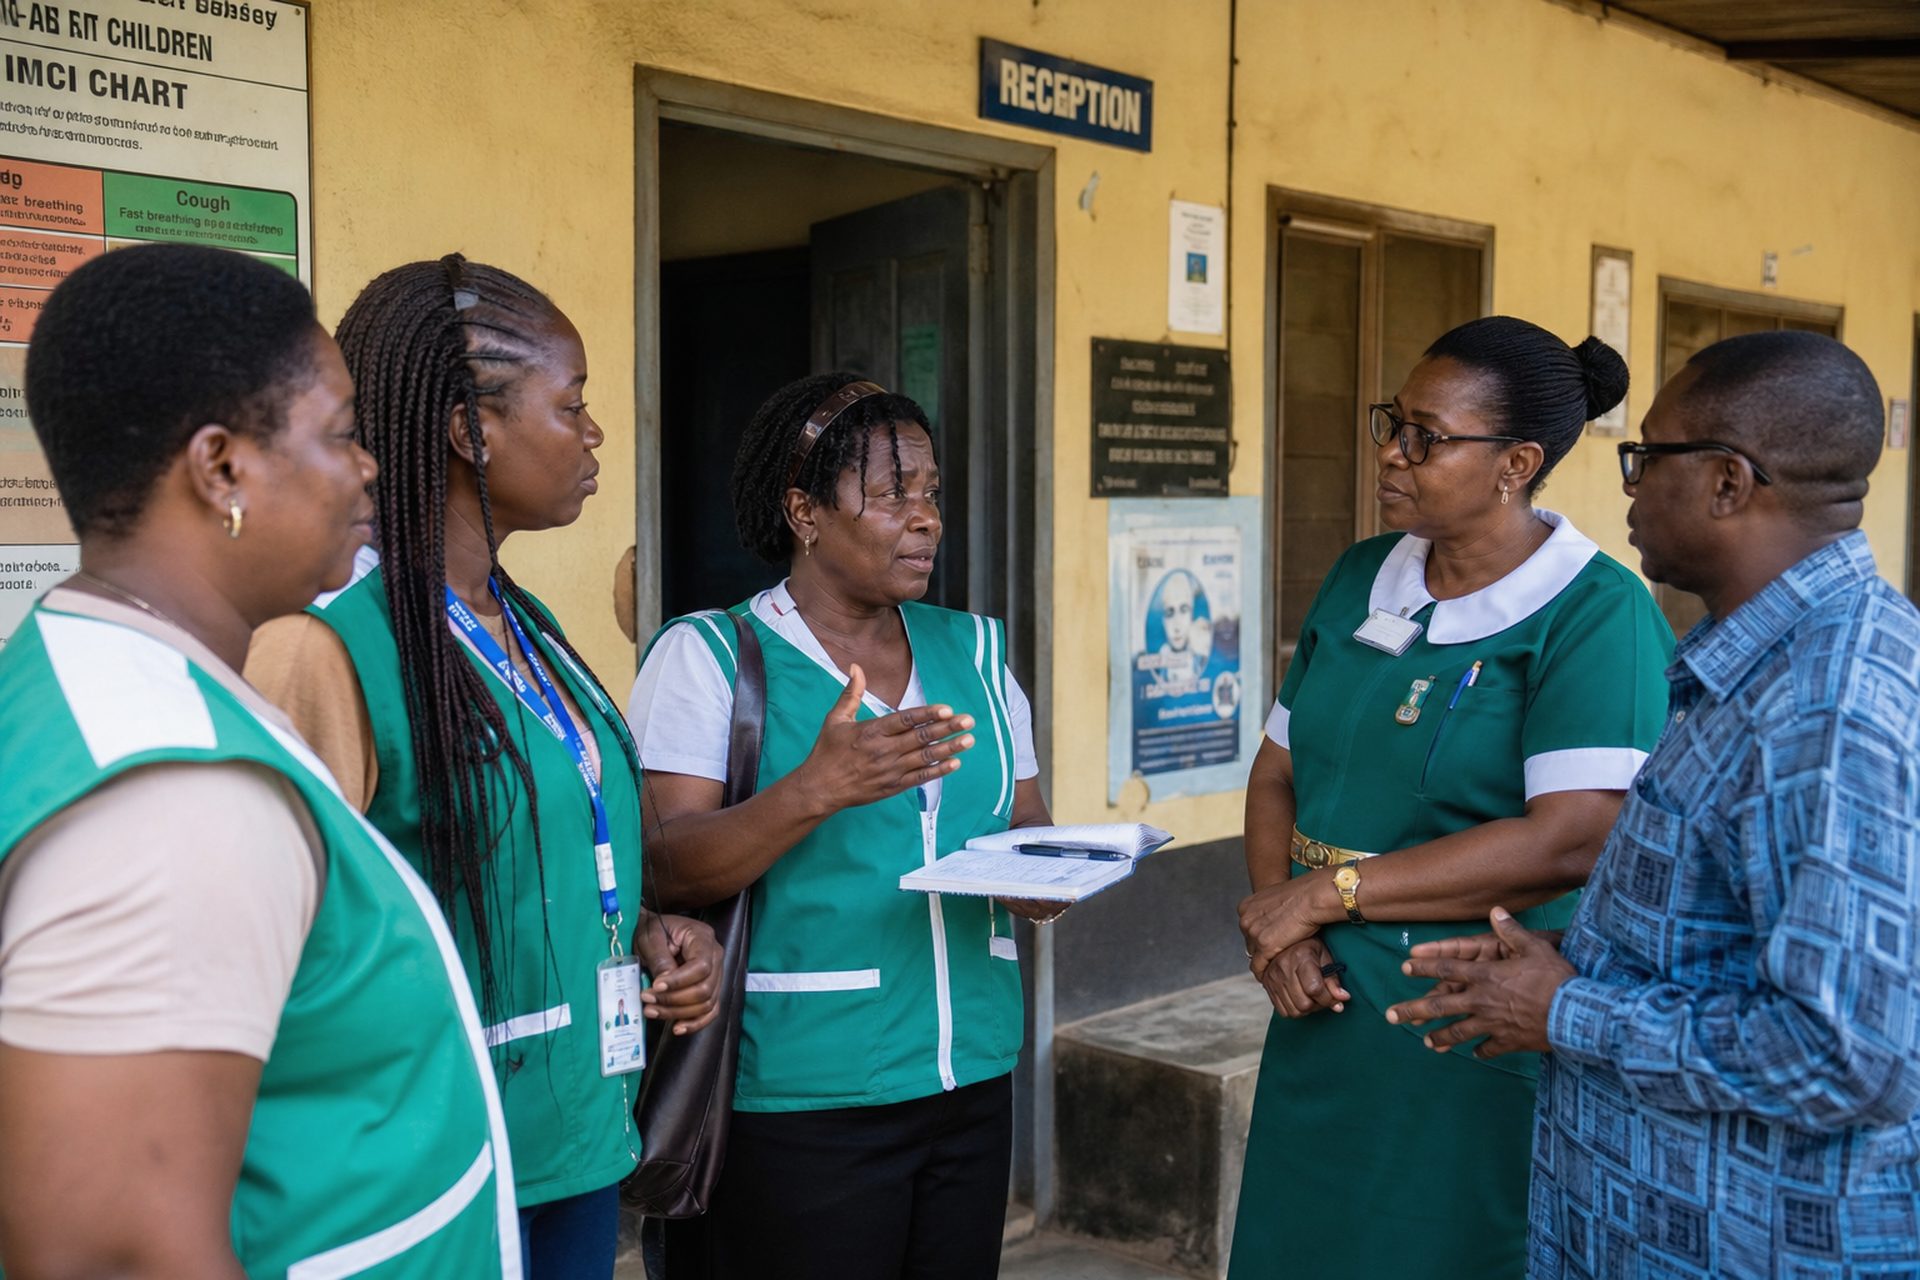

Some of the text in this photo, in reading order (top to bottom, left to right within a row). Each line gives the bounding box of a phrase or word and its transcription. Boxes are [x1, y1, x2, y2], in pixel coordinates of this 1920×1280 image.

[107, 17, 213, 62] CHILDREN
[5, 54, 188, 109] IMCI CHART
[1000, 58, 1141, 135] RECEPTION
[119, 207, 143, 219] Fast
[176, 190, 230, 213] Cough
